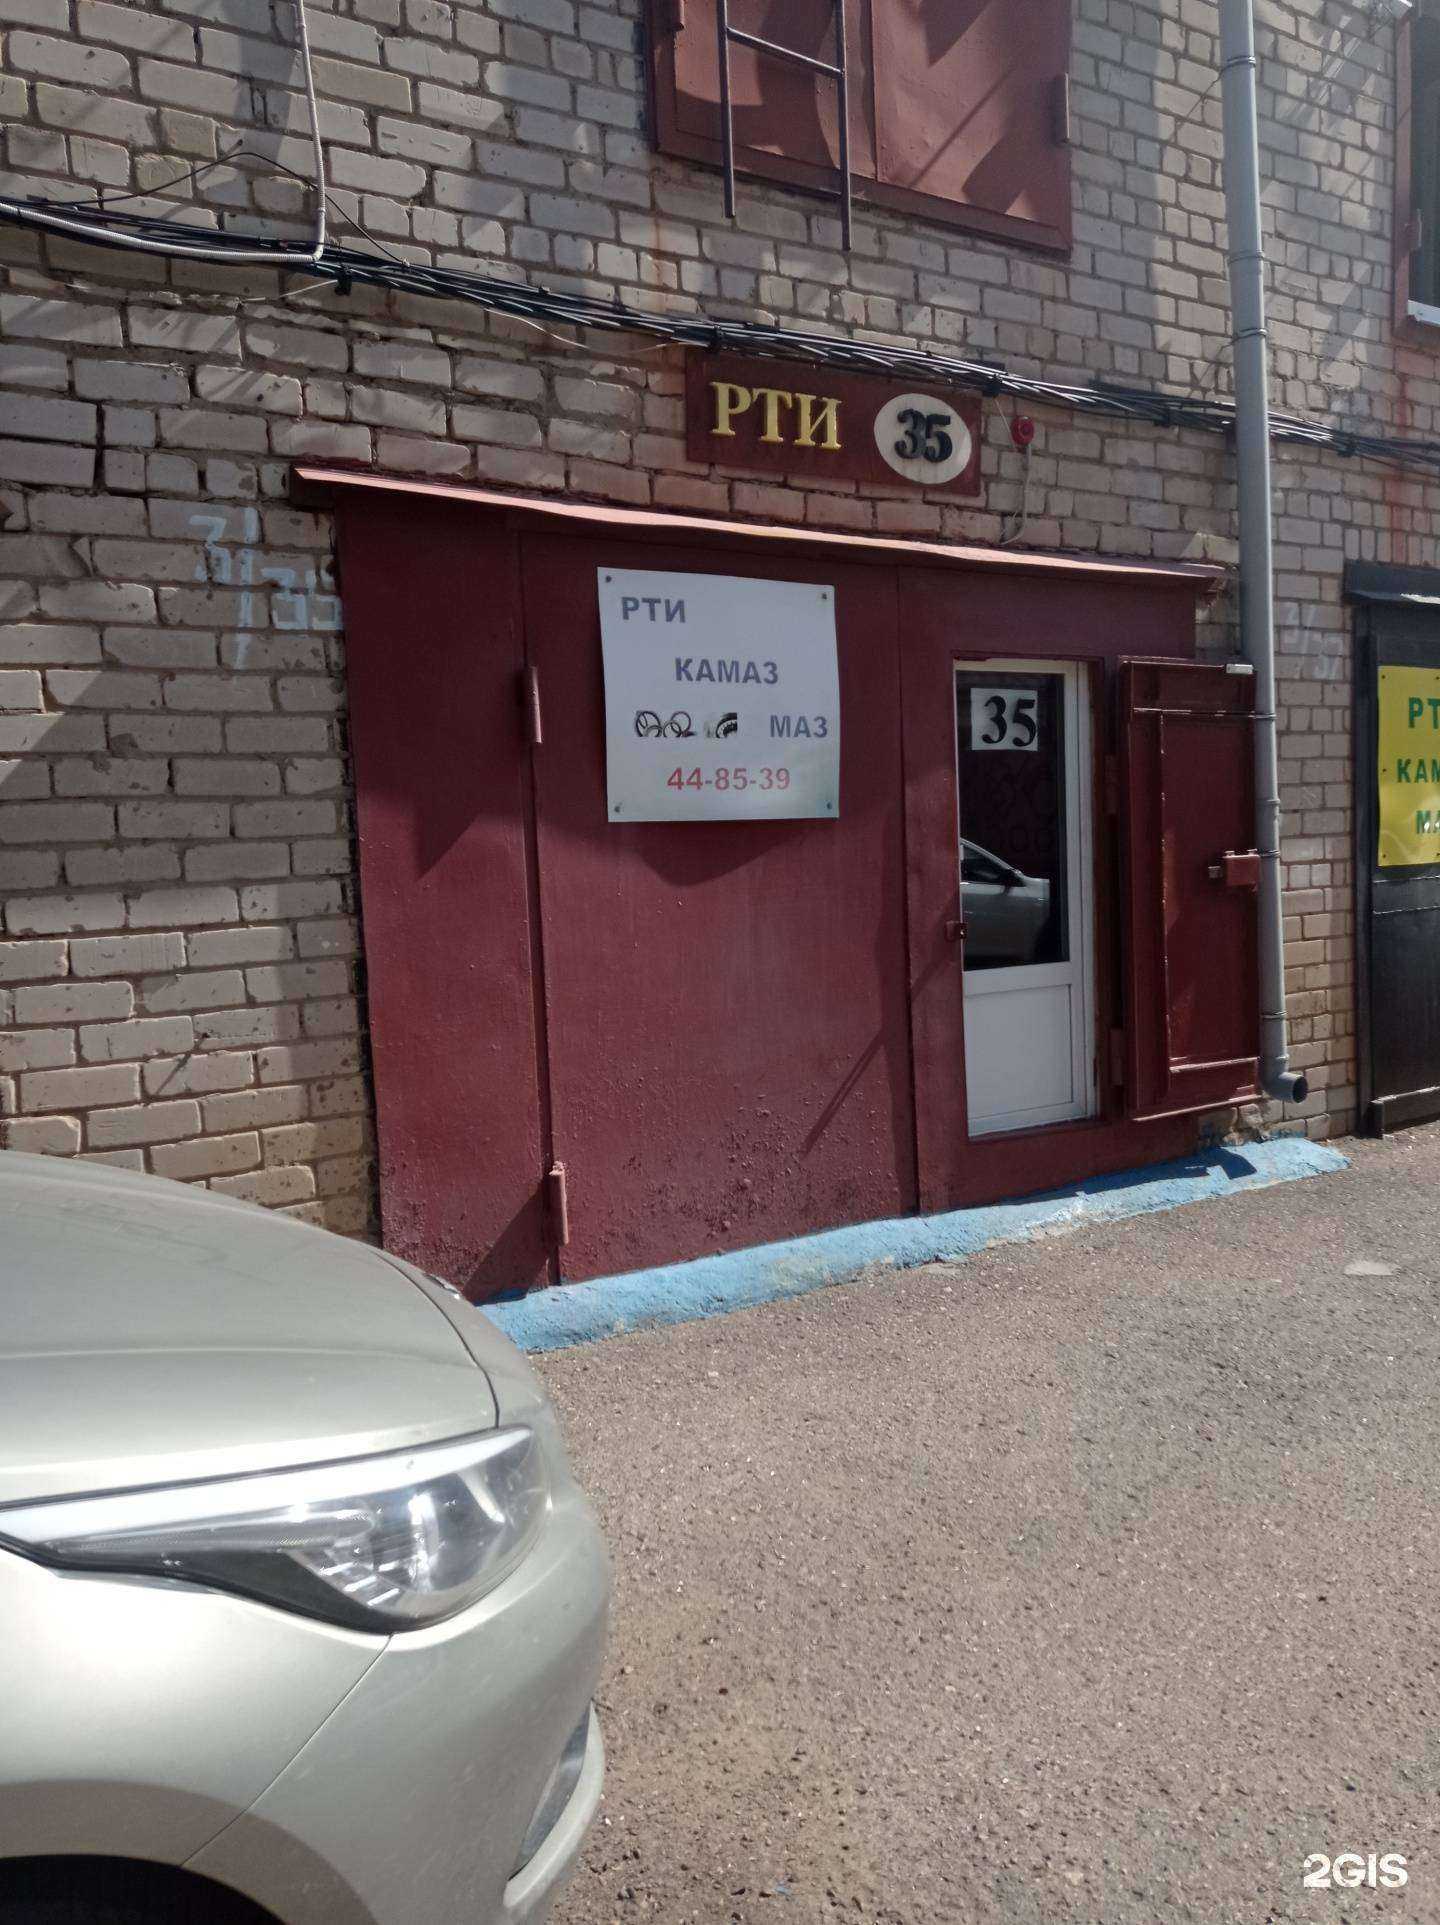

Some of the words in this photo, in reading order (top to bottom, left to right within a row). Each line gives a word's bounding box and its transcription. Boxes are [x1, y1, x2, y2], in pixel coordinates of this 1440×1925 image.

[709, 381, 842, 450] РТИ
[894, 408, 953, 463] 35
[621, 596, 687, 624] РТИ
[674, 656, 780, 685] КАМАЗ
[769, 714, 829, 739] МАЗ
[981, 695, 1037, 748] 35
[667, 766, 791, 791] 44-85-39
